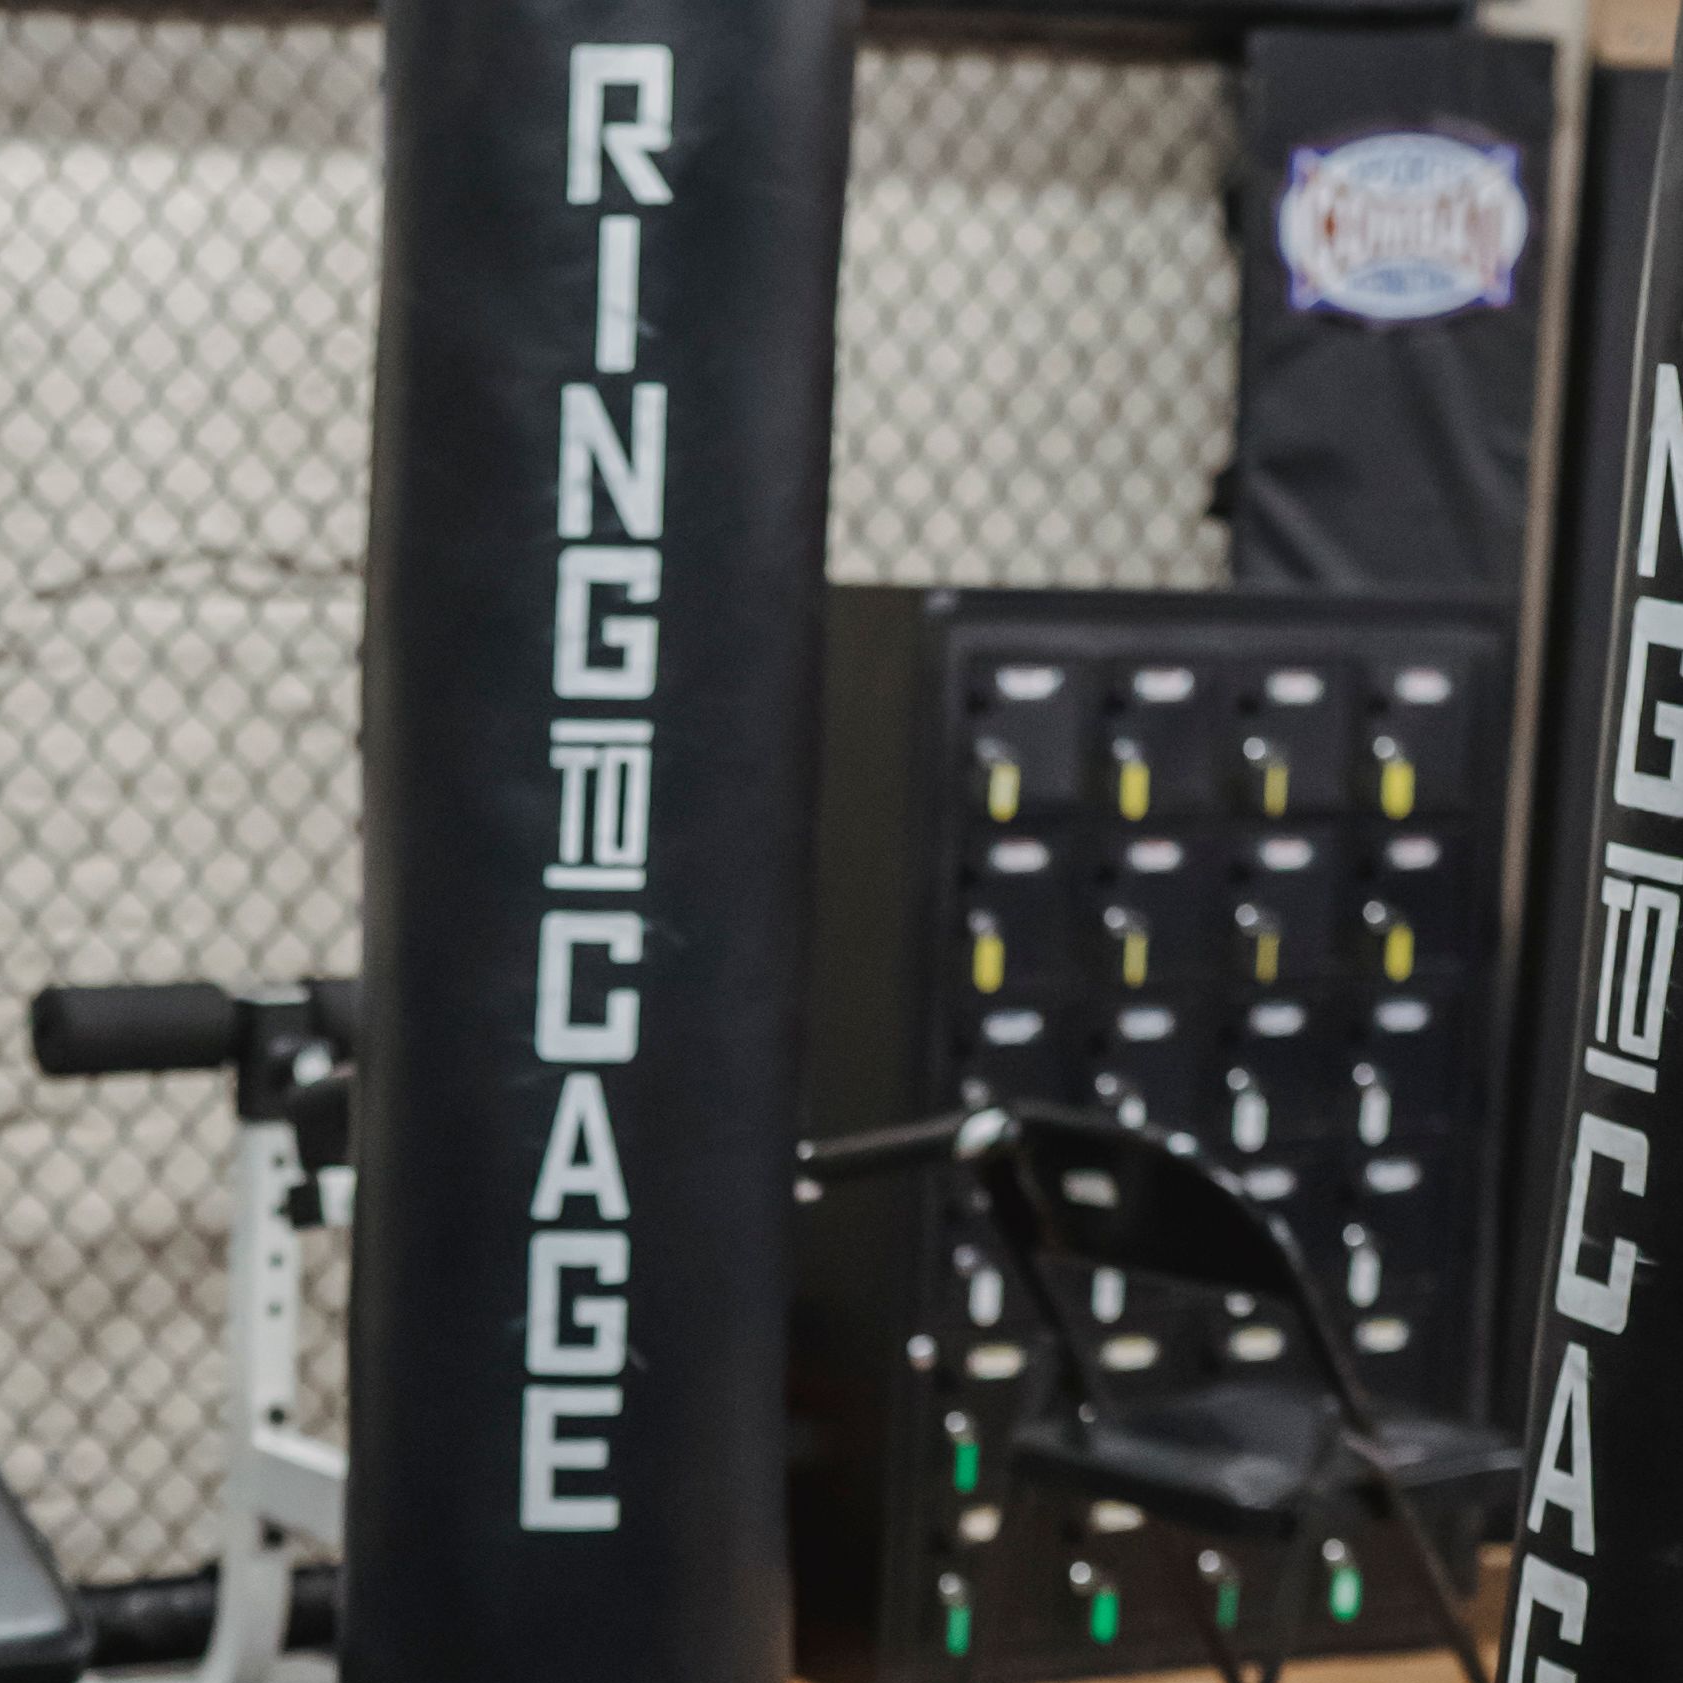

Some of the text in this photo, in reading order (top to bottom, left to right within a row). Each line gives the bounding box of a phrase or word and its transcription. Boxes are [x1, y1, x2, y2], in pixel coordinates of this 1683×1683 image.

[520, 43, 674, 1532] RING TO CAGE
[1595, 876, 1681, 1061] TO
